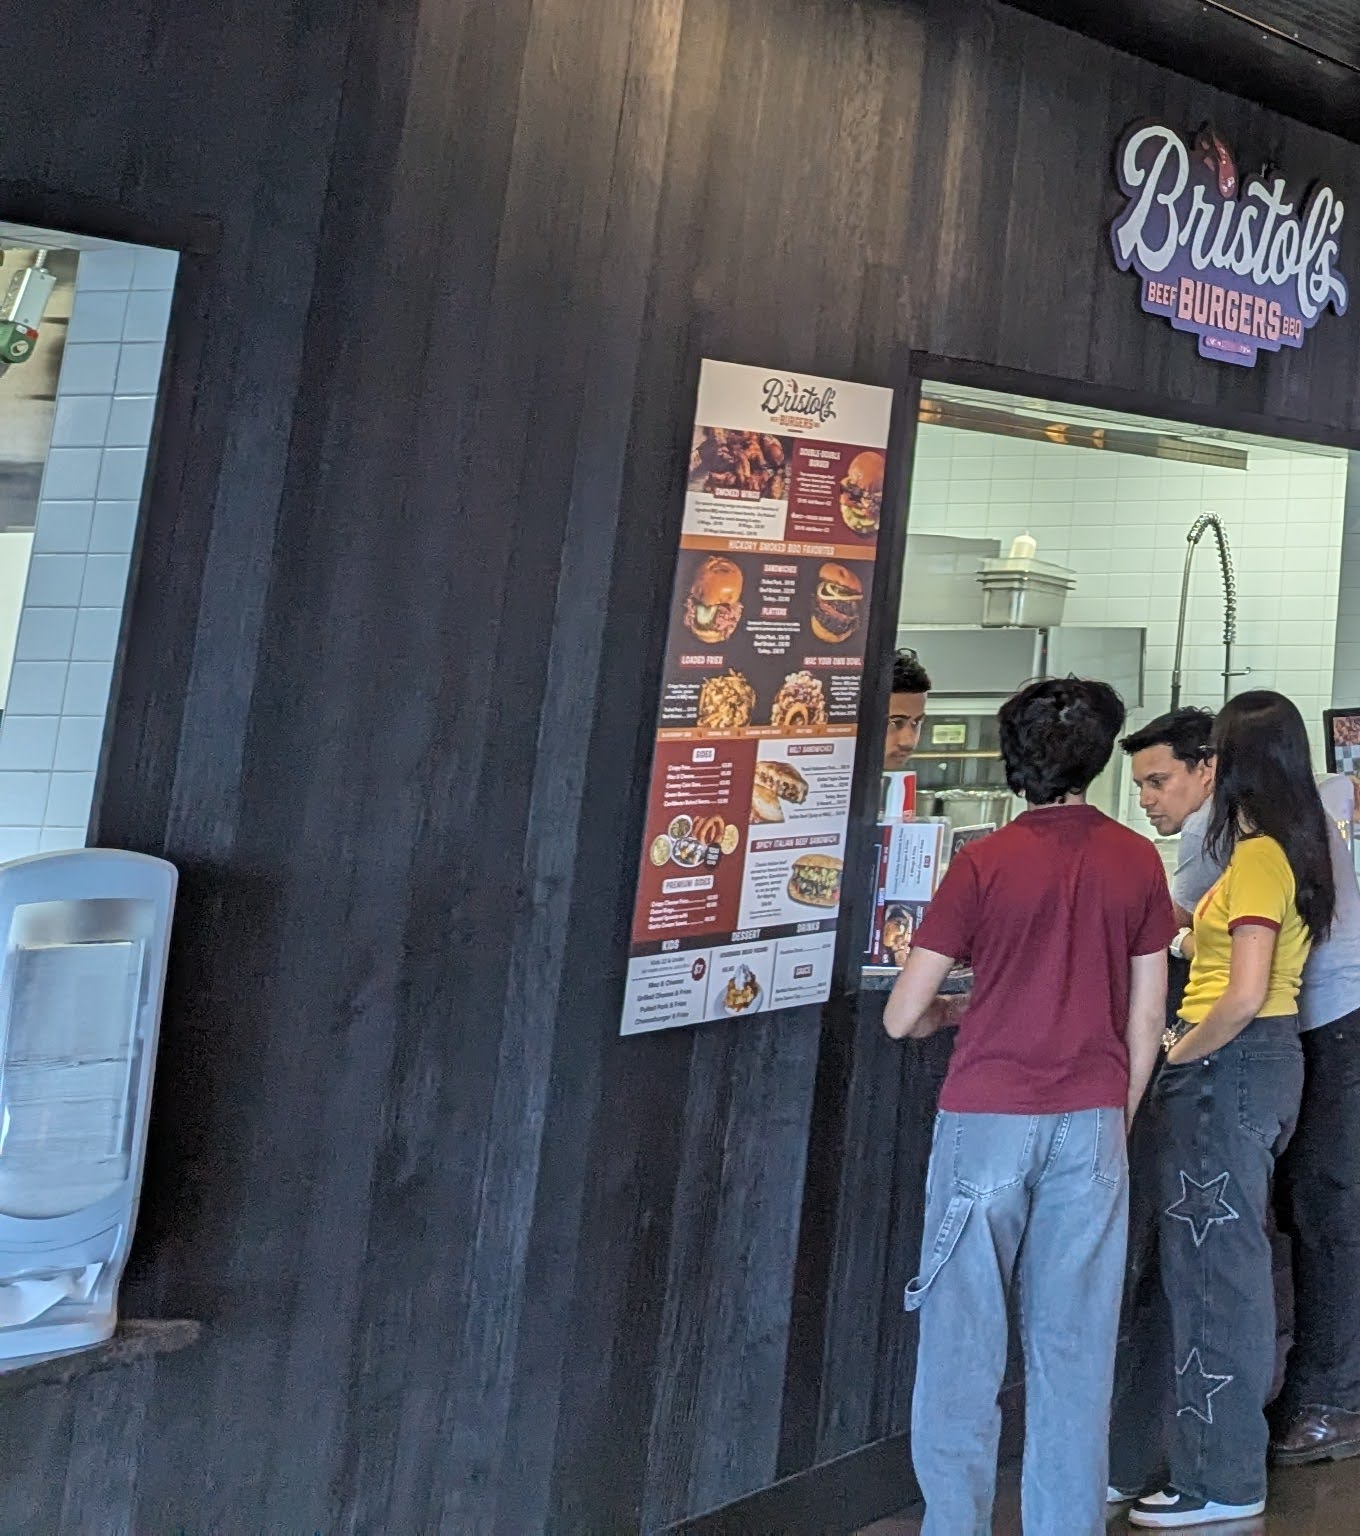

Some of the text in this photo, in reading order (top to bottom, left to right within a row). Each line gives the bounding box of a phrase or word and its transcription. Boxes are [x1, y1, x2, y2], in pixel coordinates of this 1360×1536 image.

[1117, 125, 1347, 319] Bristol's
[1147, 277, 1302, 341] BEEF BURGERS BBQ
[761, 377, 837, 423] Bristol's
[730, 928, 761, 942] DESSERT
